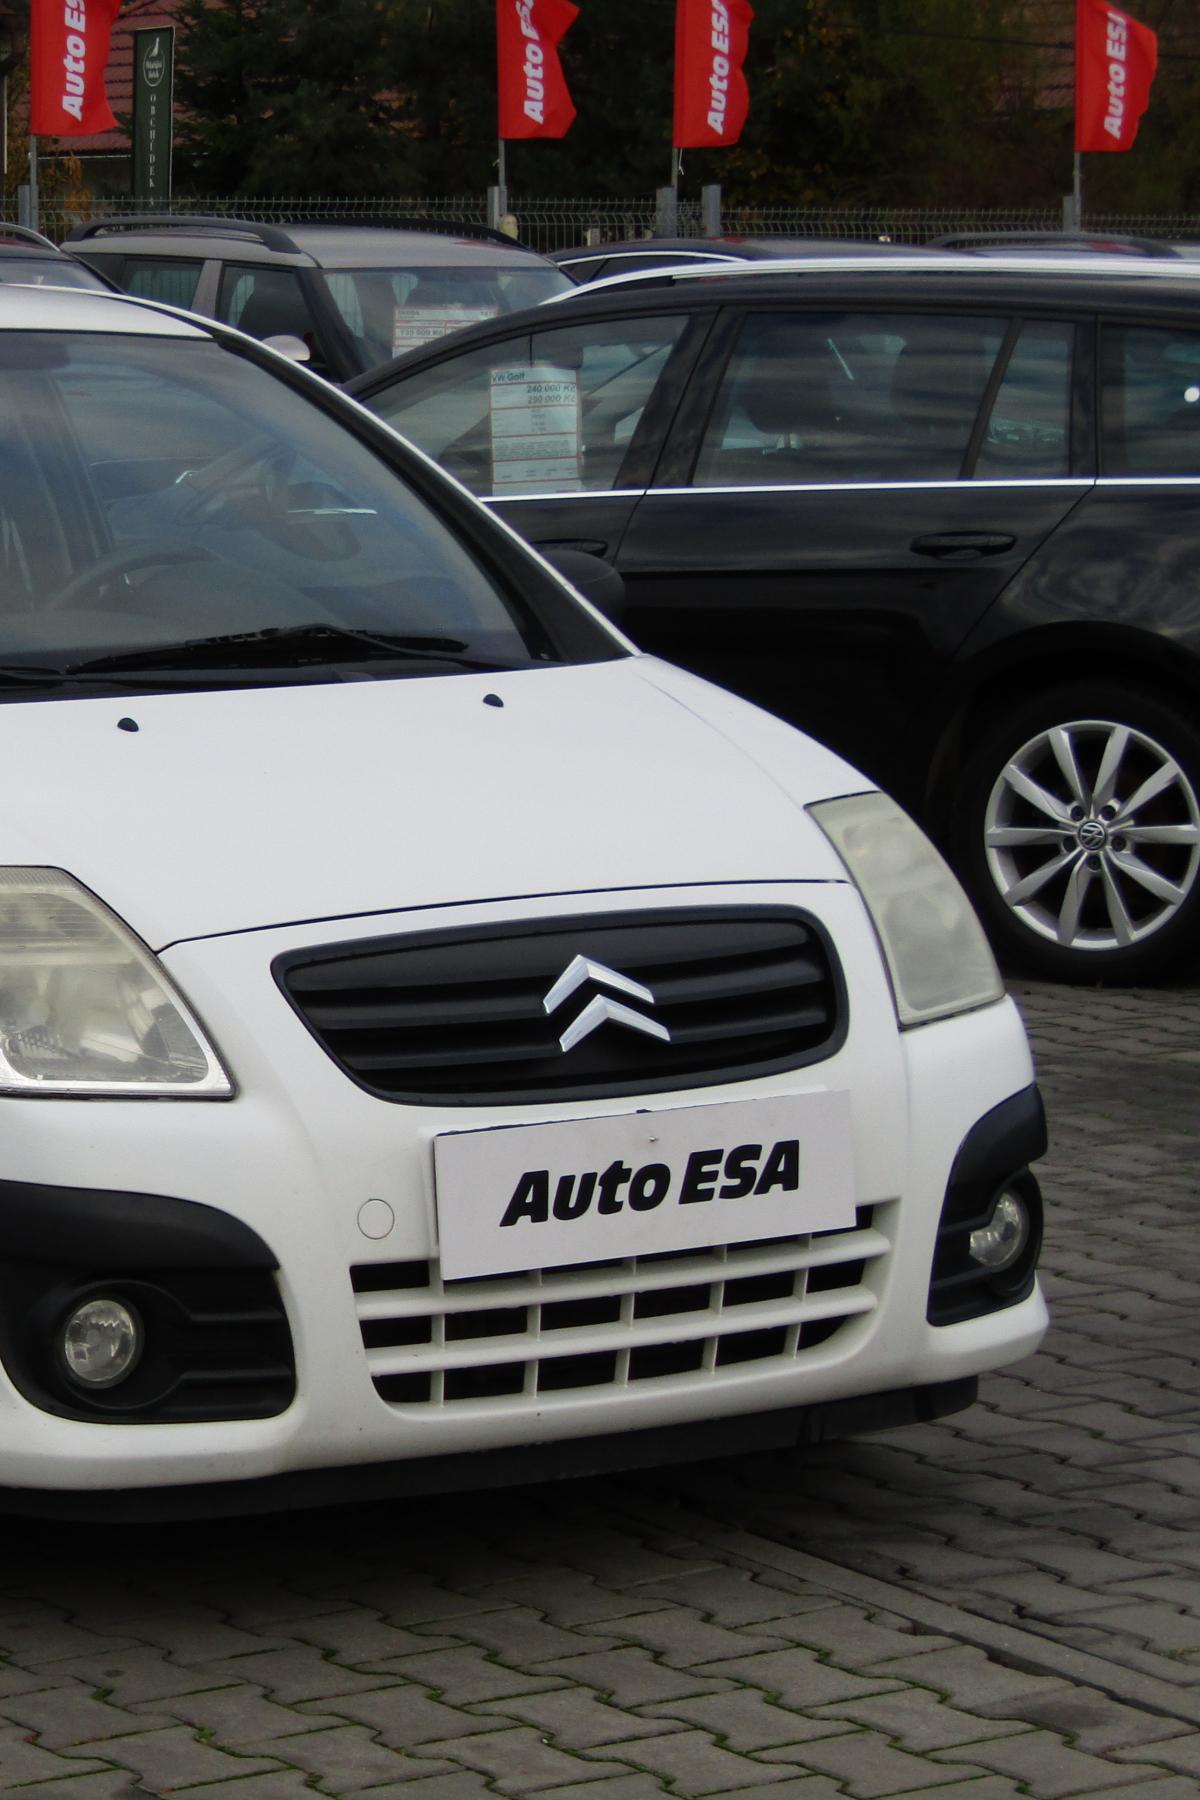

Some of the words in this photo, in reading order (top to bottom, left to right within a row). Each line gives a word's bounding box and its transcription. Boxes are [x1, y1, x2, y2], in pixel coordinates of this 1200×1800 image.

[62, 34, 86, 121] Auto
[523, 43, 544, 125] Auto
[707, 56, 729, 135] Auto
[1104, 63, 1126, 139] Auto
[507, 372, 525, 382] Golf
[544, 384, 561, 393] 000
[499, 1160, 671, 1227] Auto
[678, 1139, 800, 1205] ESA
